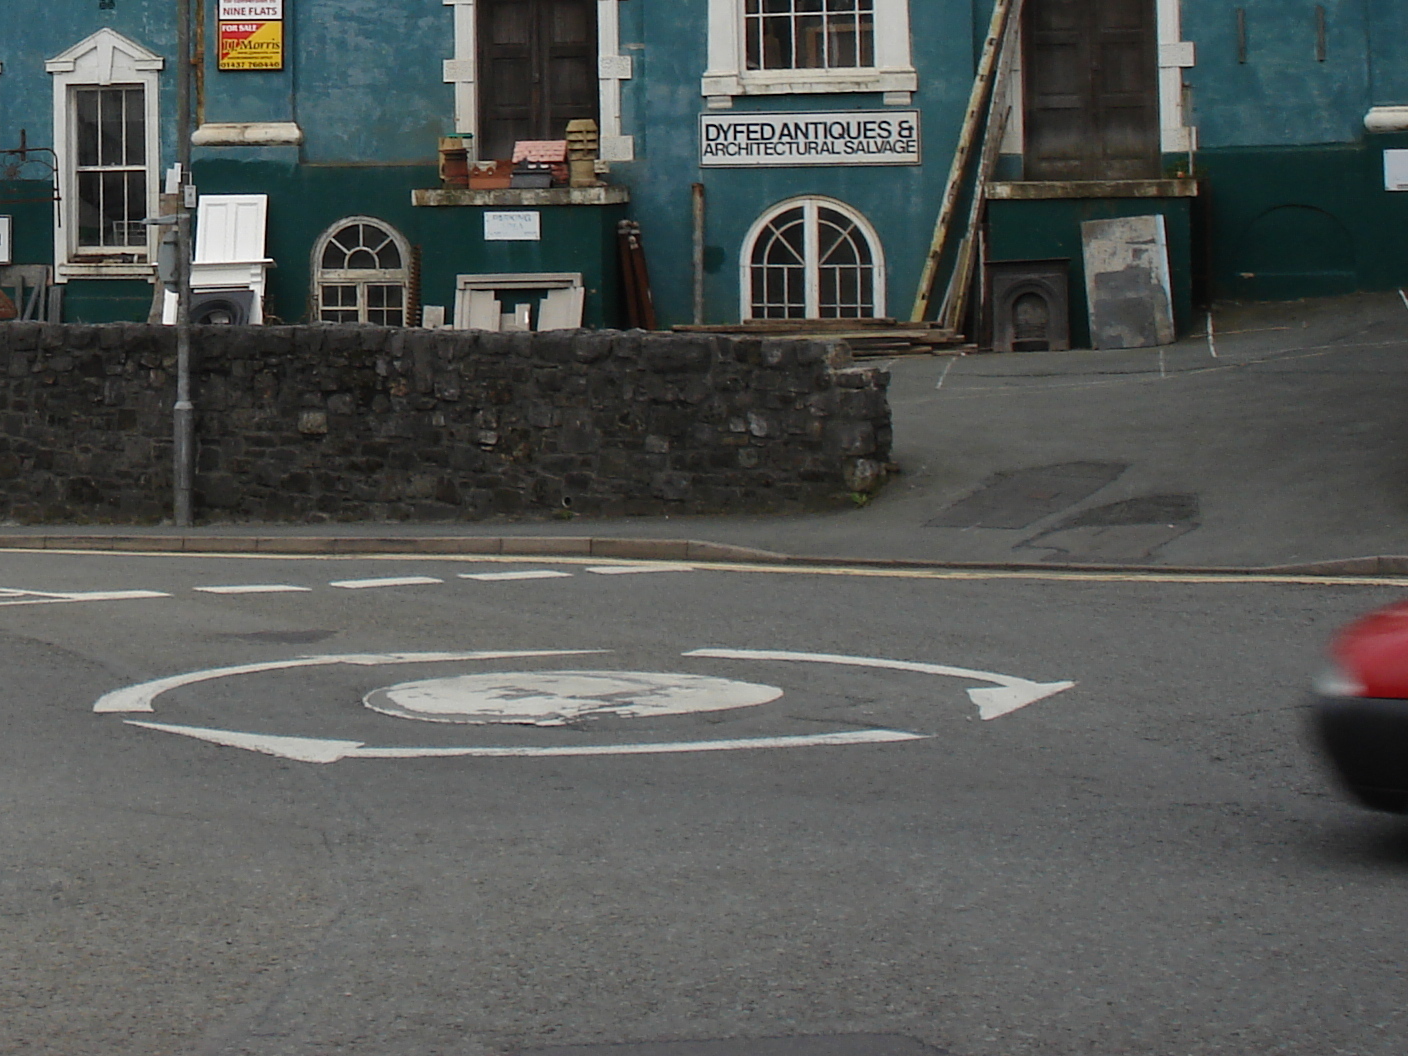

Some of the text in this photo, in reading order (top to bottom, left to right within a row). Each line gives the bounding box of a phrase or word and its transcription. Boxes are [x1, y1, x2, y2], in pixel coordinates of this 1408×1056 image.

[223, 7, 277, 16] NINE FLATS
[240, 38, 280, 50] Morris
[705, 120, 914, 142] DYFED ANTIQUES &
[703, 140, 916, 156] ARCHITECTURAL SALVAGE
